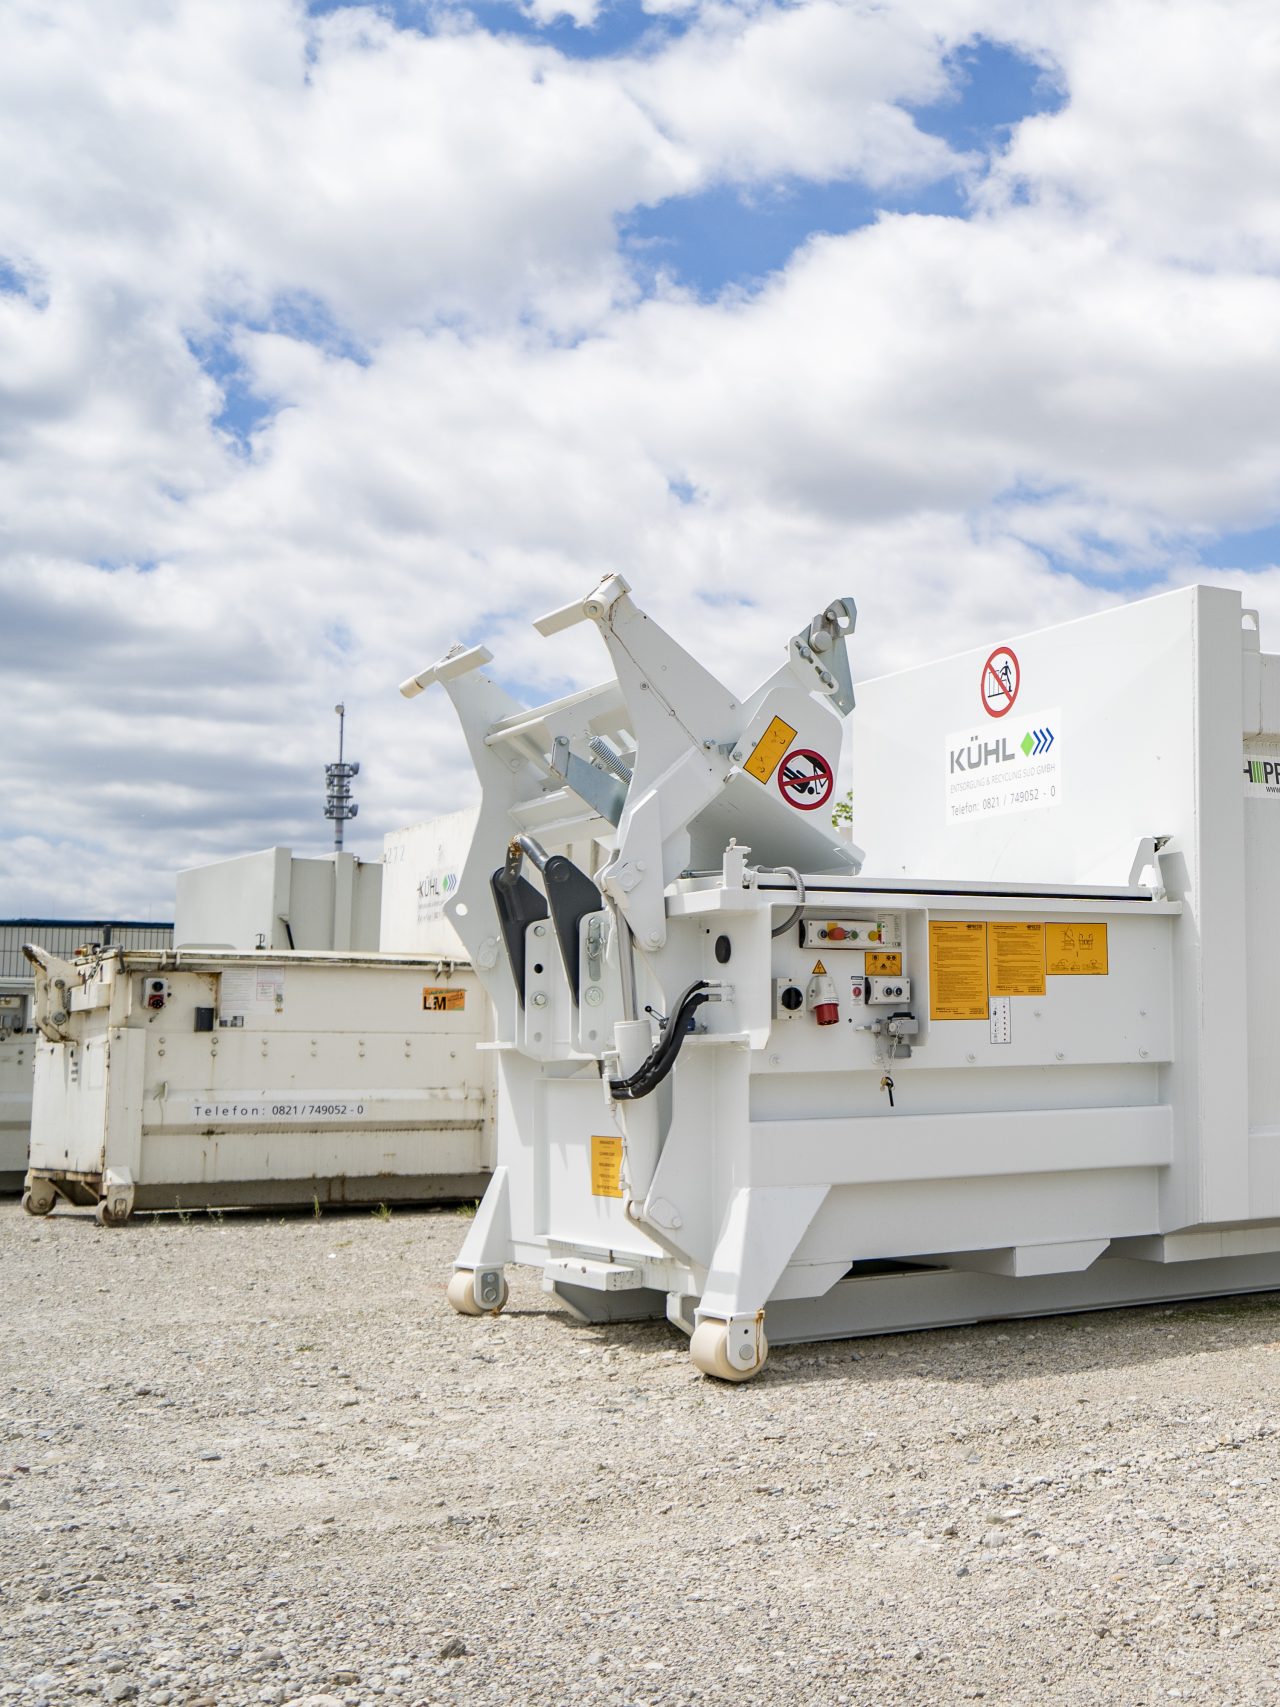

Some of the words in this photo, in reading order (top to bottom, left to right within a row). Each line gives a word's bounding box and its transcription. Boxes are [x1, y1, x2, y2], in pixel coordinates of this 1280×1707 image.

[950, 735, 1015, 774] KÜHL
[991, 768, 1022, 784] RECYCLING
[983, 796, 1000, 810] 0821
[1010, 788, 1039, 804] 749052
[1050, 785, 1056, 797] 0
[194, 1105, 265, 1116] Telefon:
[272, 1105, 298, 1116] 0821
[308, 1104, 347, 1115] 749052
[357, 1105, 364, 1115] 0
